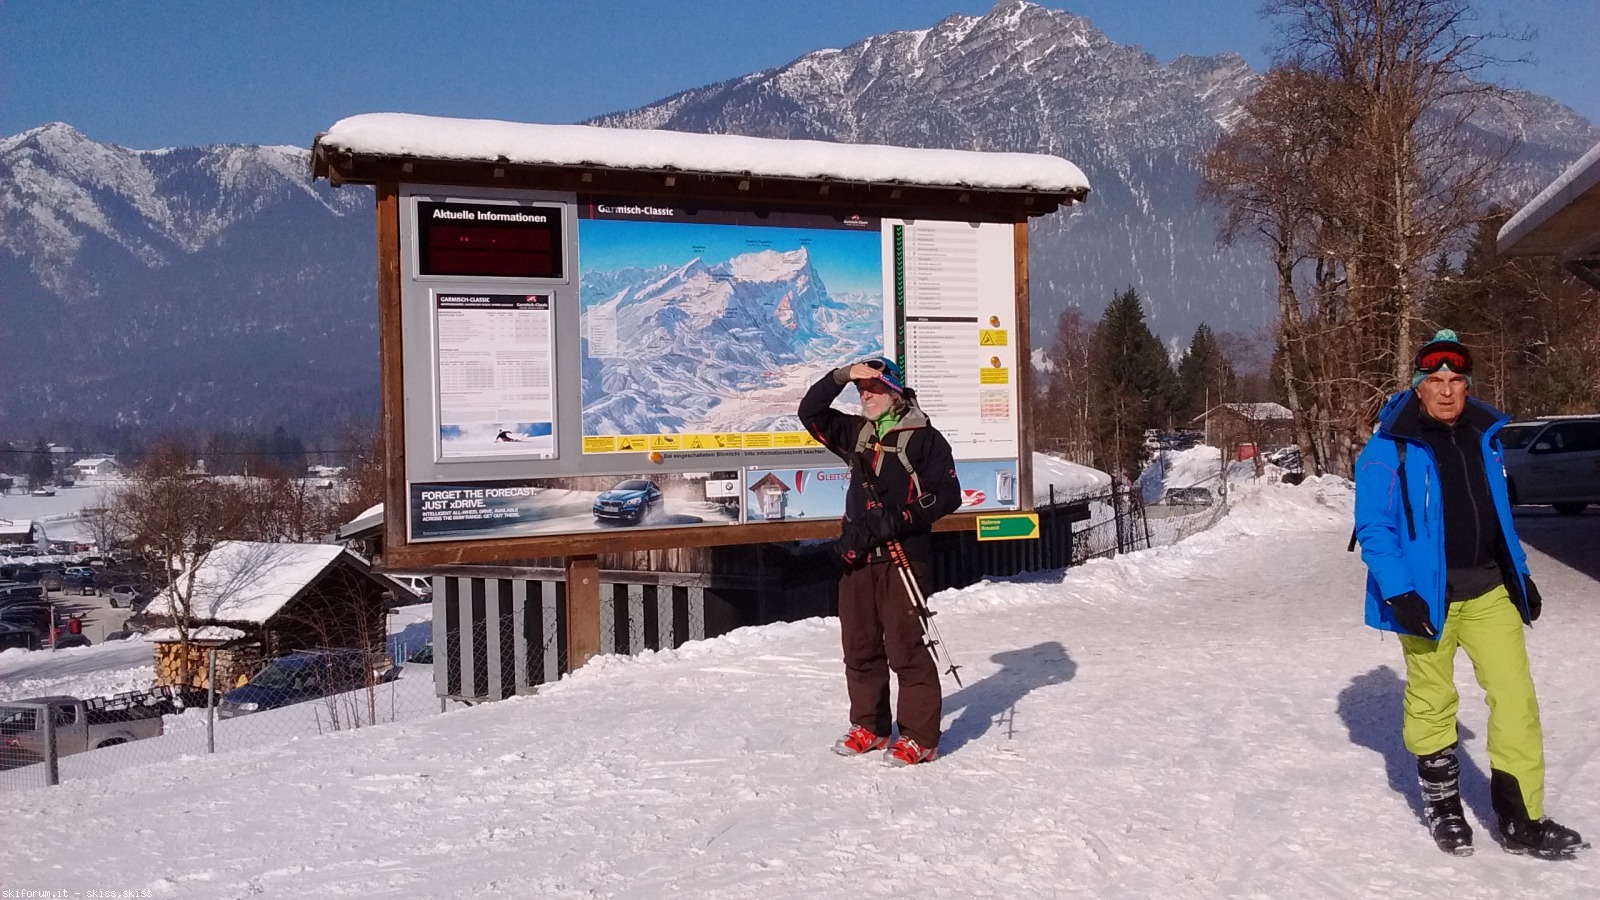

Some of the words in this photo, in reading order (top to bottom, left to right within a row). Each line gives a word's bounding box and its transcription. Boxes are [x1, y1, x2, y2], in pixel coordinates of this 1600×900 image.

[432, 208, 475, 220] Aktuelle
[477, 210, 547, 223] Informationen
[597, 204, 674, 216] Garmisch-Classic
[421, 490, 461, 501] FORGET
[463, 489, 483, 499] THE
[485, 487, 537, 498] FORECAST.
[421, 501, 448, 510] JUST
[449, 499, 486, 509] xDRIVE.
